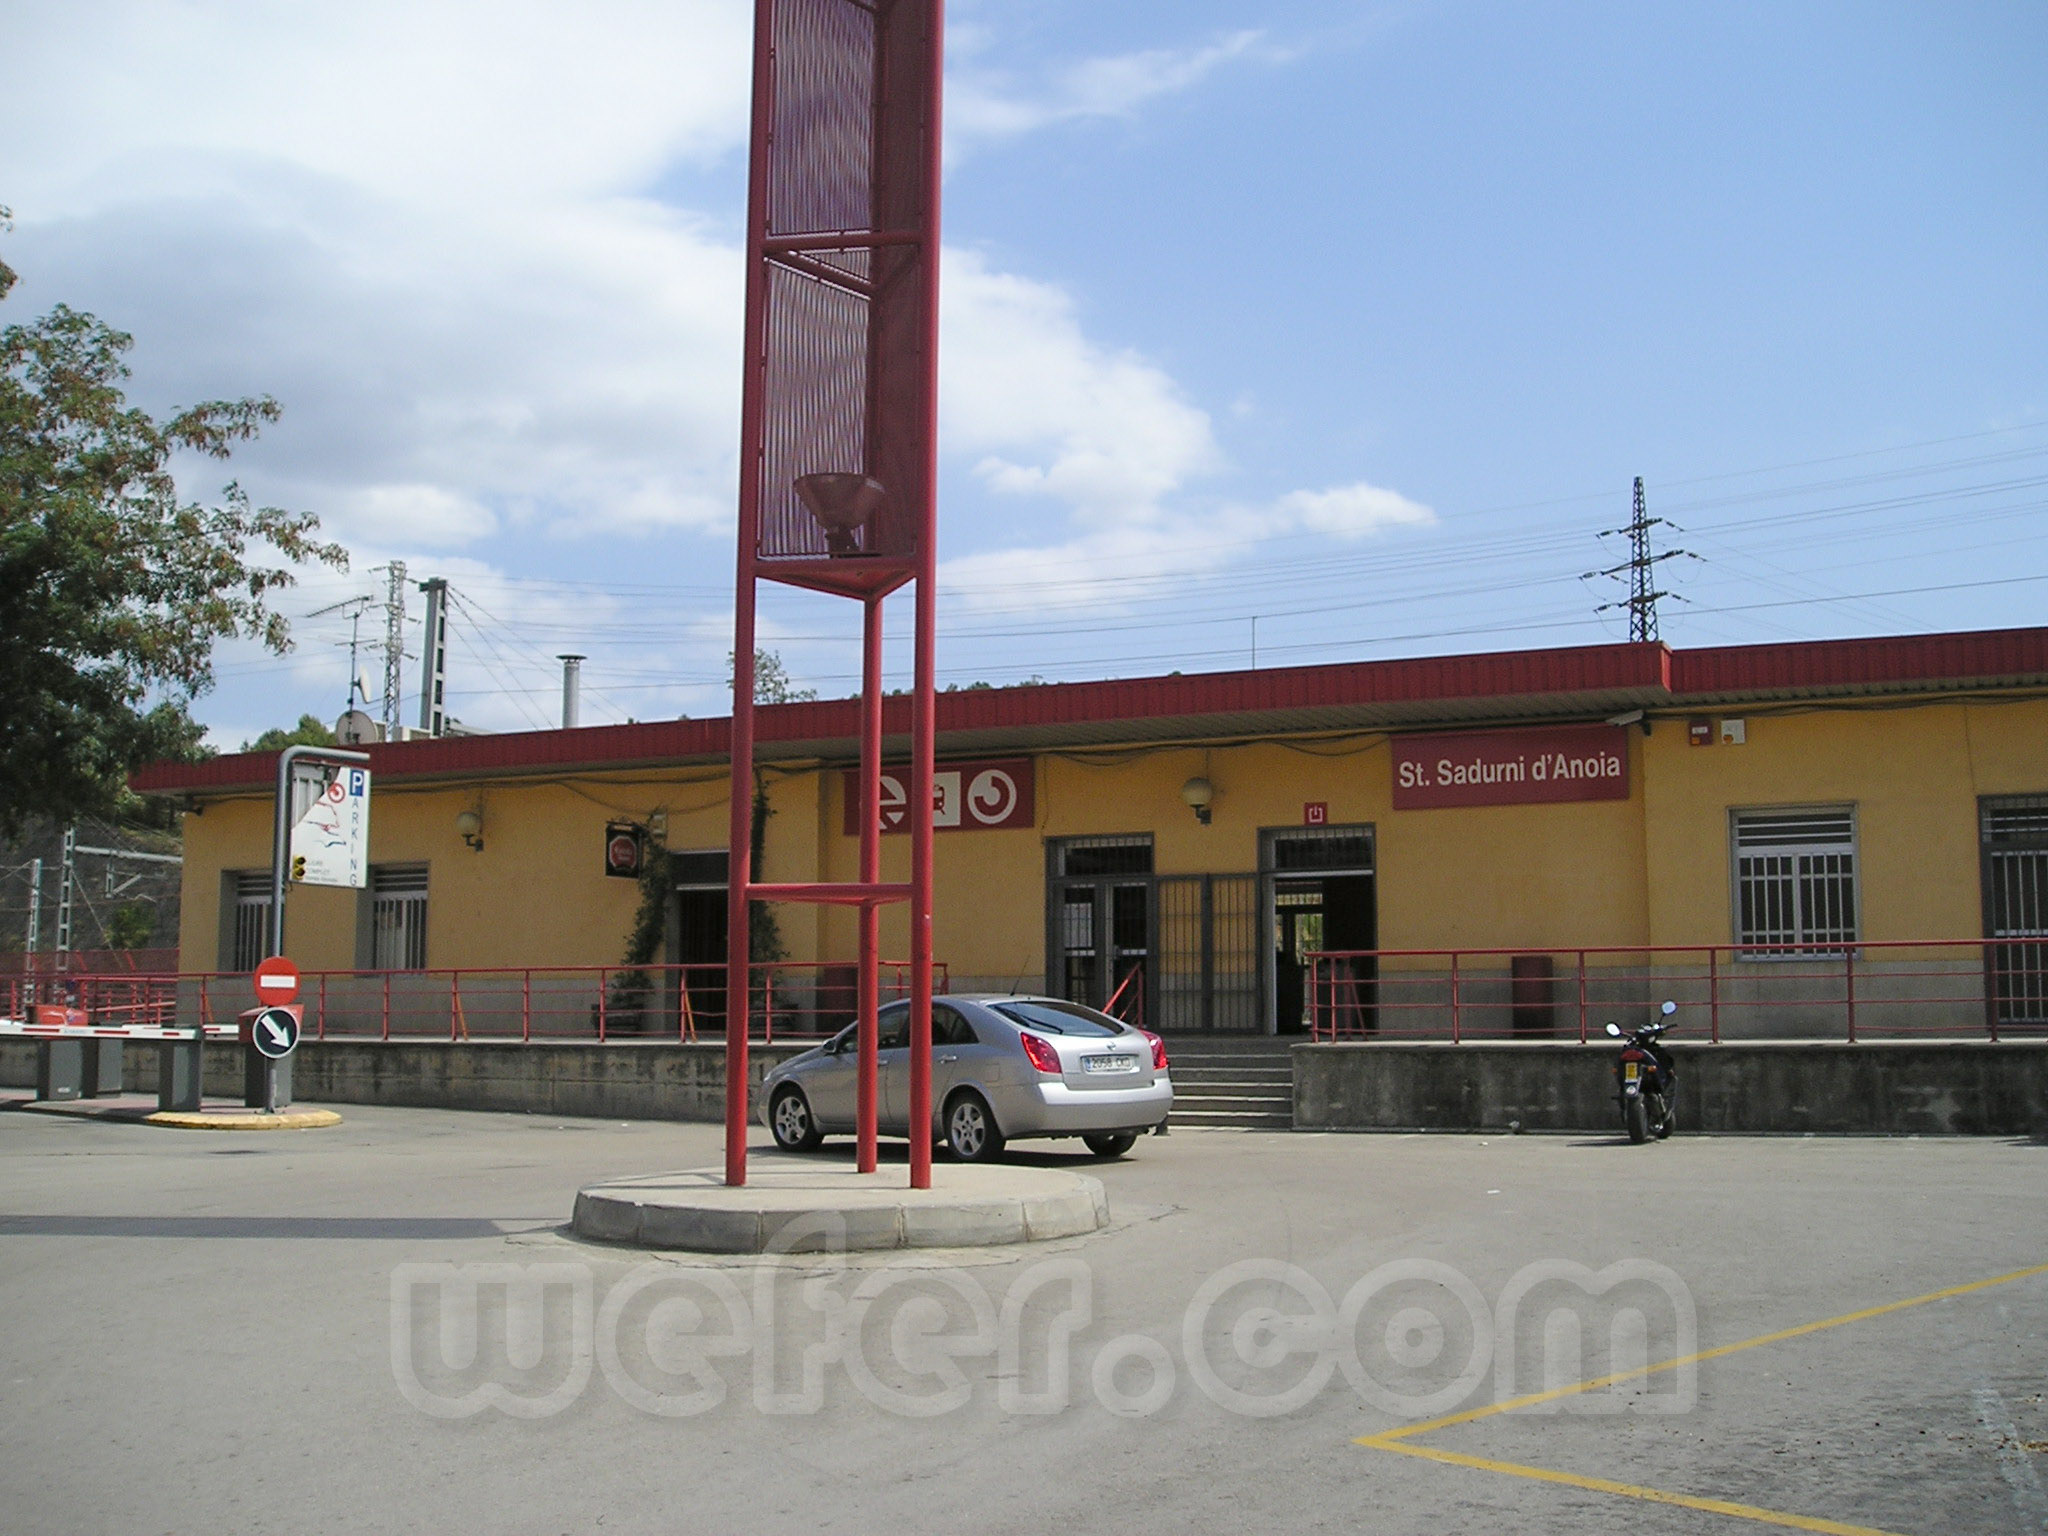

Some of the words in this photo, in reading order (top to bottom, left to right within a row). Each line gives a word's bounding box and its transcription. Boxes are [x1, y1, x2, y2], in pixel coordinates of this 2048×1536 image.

[1399, 761, 1430, 788] St.
[1437, 756, 1526, 787] Sadurni
[1532, 751, 1621, 782] d'Anoia
